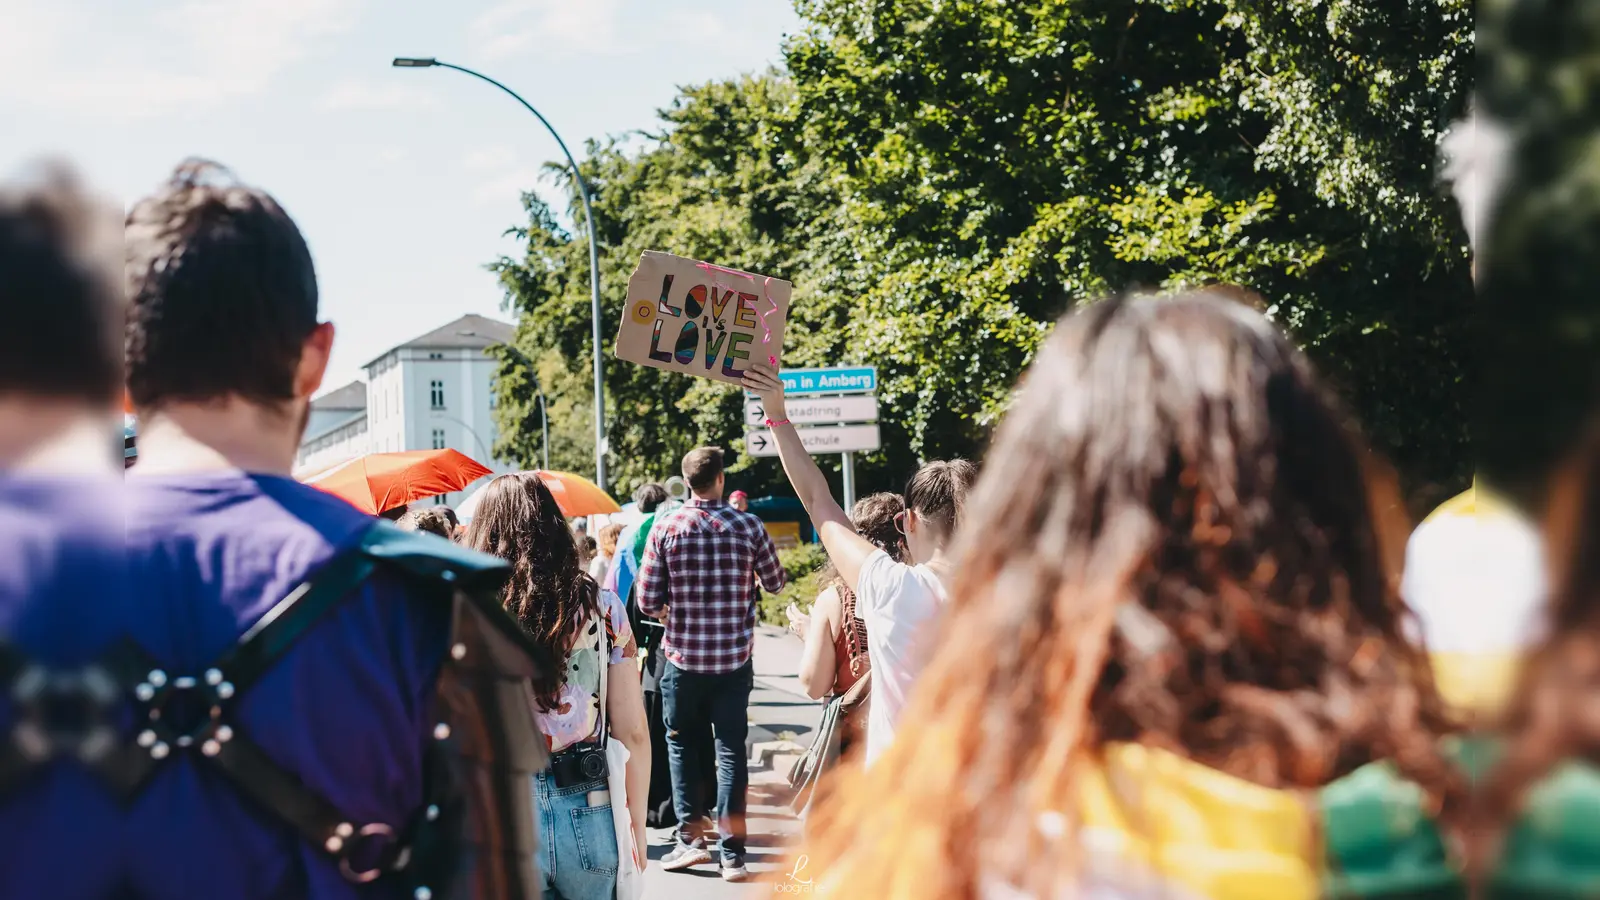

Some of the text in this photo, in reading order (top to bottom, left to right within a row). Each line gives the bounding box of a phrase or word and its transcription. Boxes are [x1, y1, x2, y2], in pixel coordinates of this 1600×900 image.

[658, 274, 759, 329] LOVE
[649, 318, 754, 379] LOVE
[800, 376, 813, 388] in
[819, 374, 871, 389] Amberg
